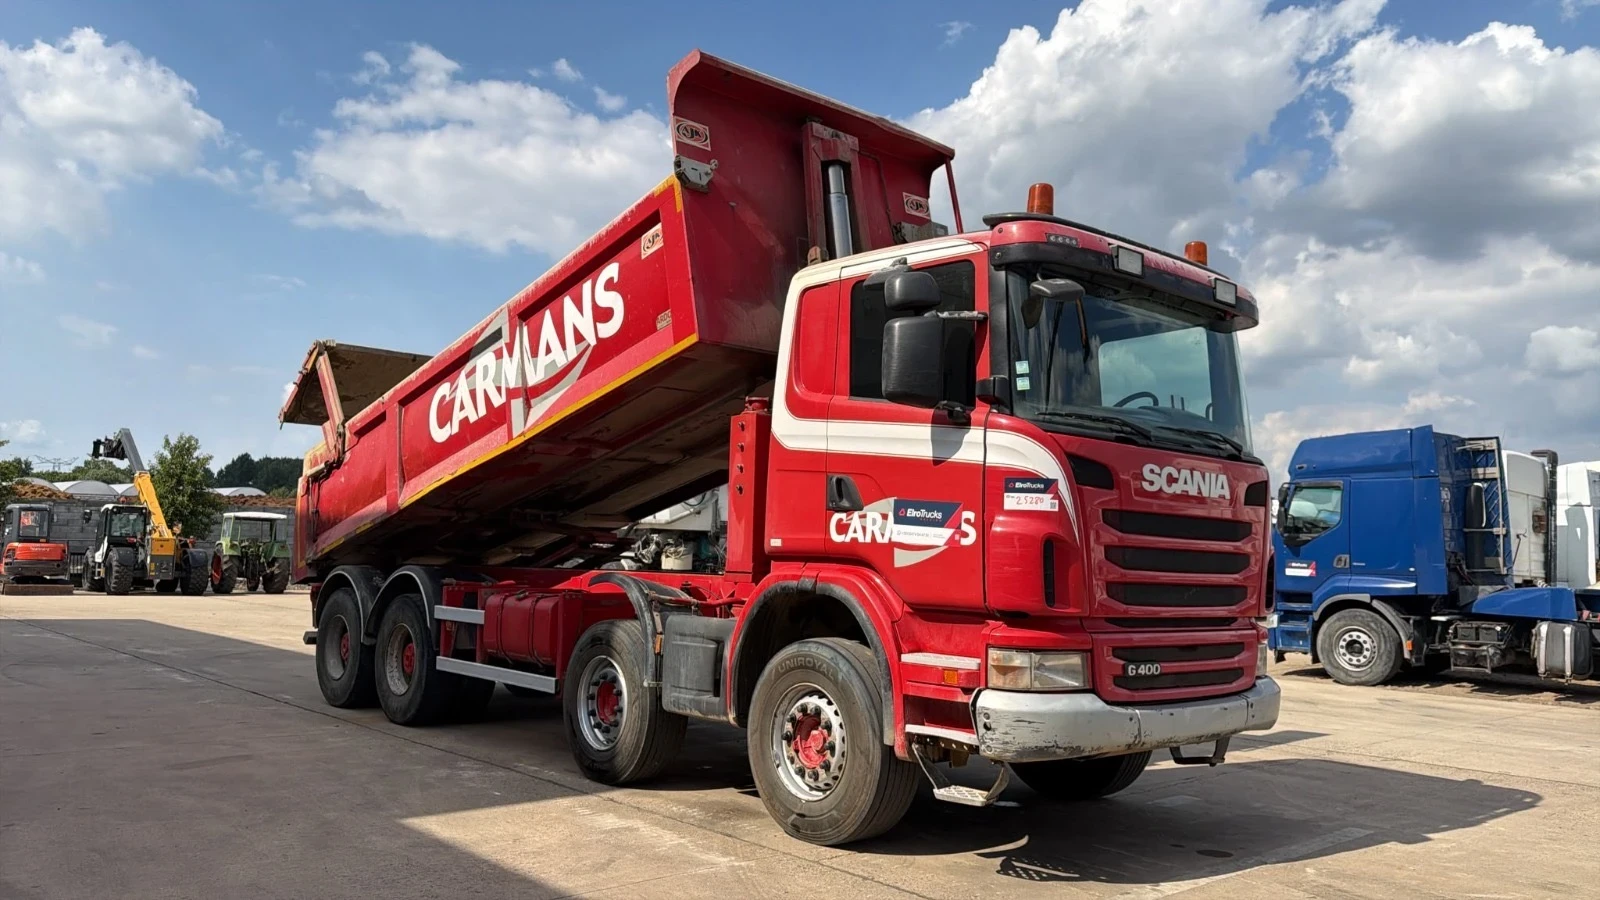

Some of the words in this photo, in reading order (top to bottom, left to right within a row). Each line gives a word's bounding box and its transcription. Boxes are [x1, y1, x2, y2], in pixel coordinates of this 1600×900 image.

[428, 261, 625, 444] CARMANS
[1141, 463, 1231, 500] SCANIA
[906, 508, 943, 519] ElroTrucks
[778, 656, 834, 681] UNIROYAL
[1127, 664, 1136, 676] G
[1137, 663, 1161, 675] 400
